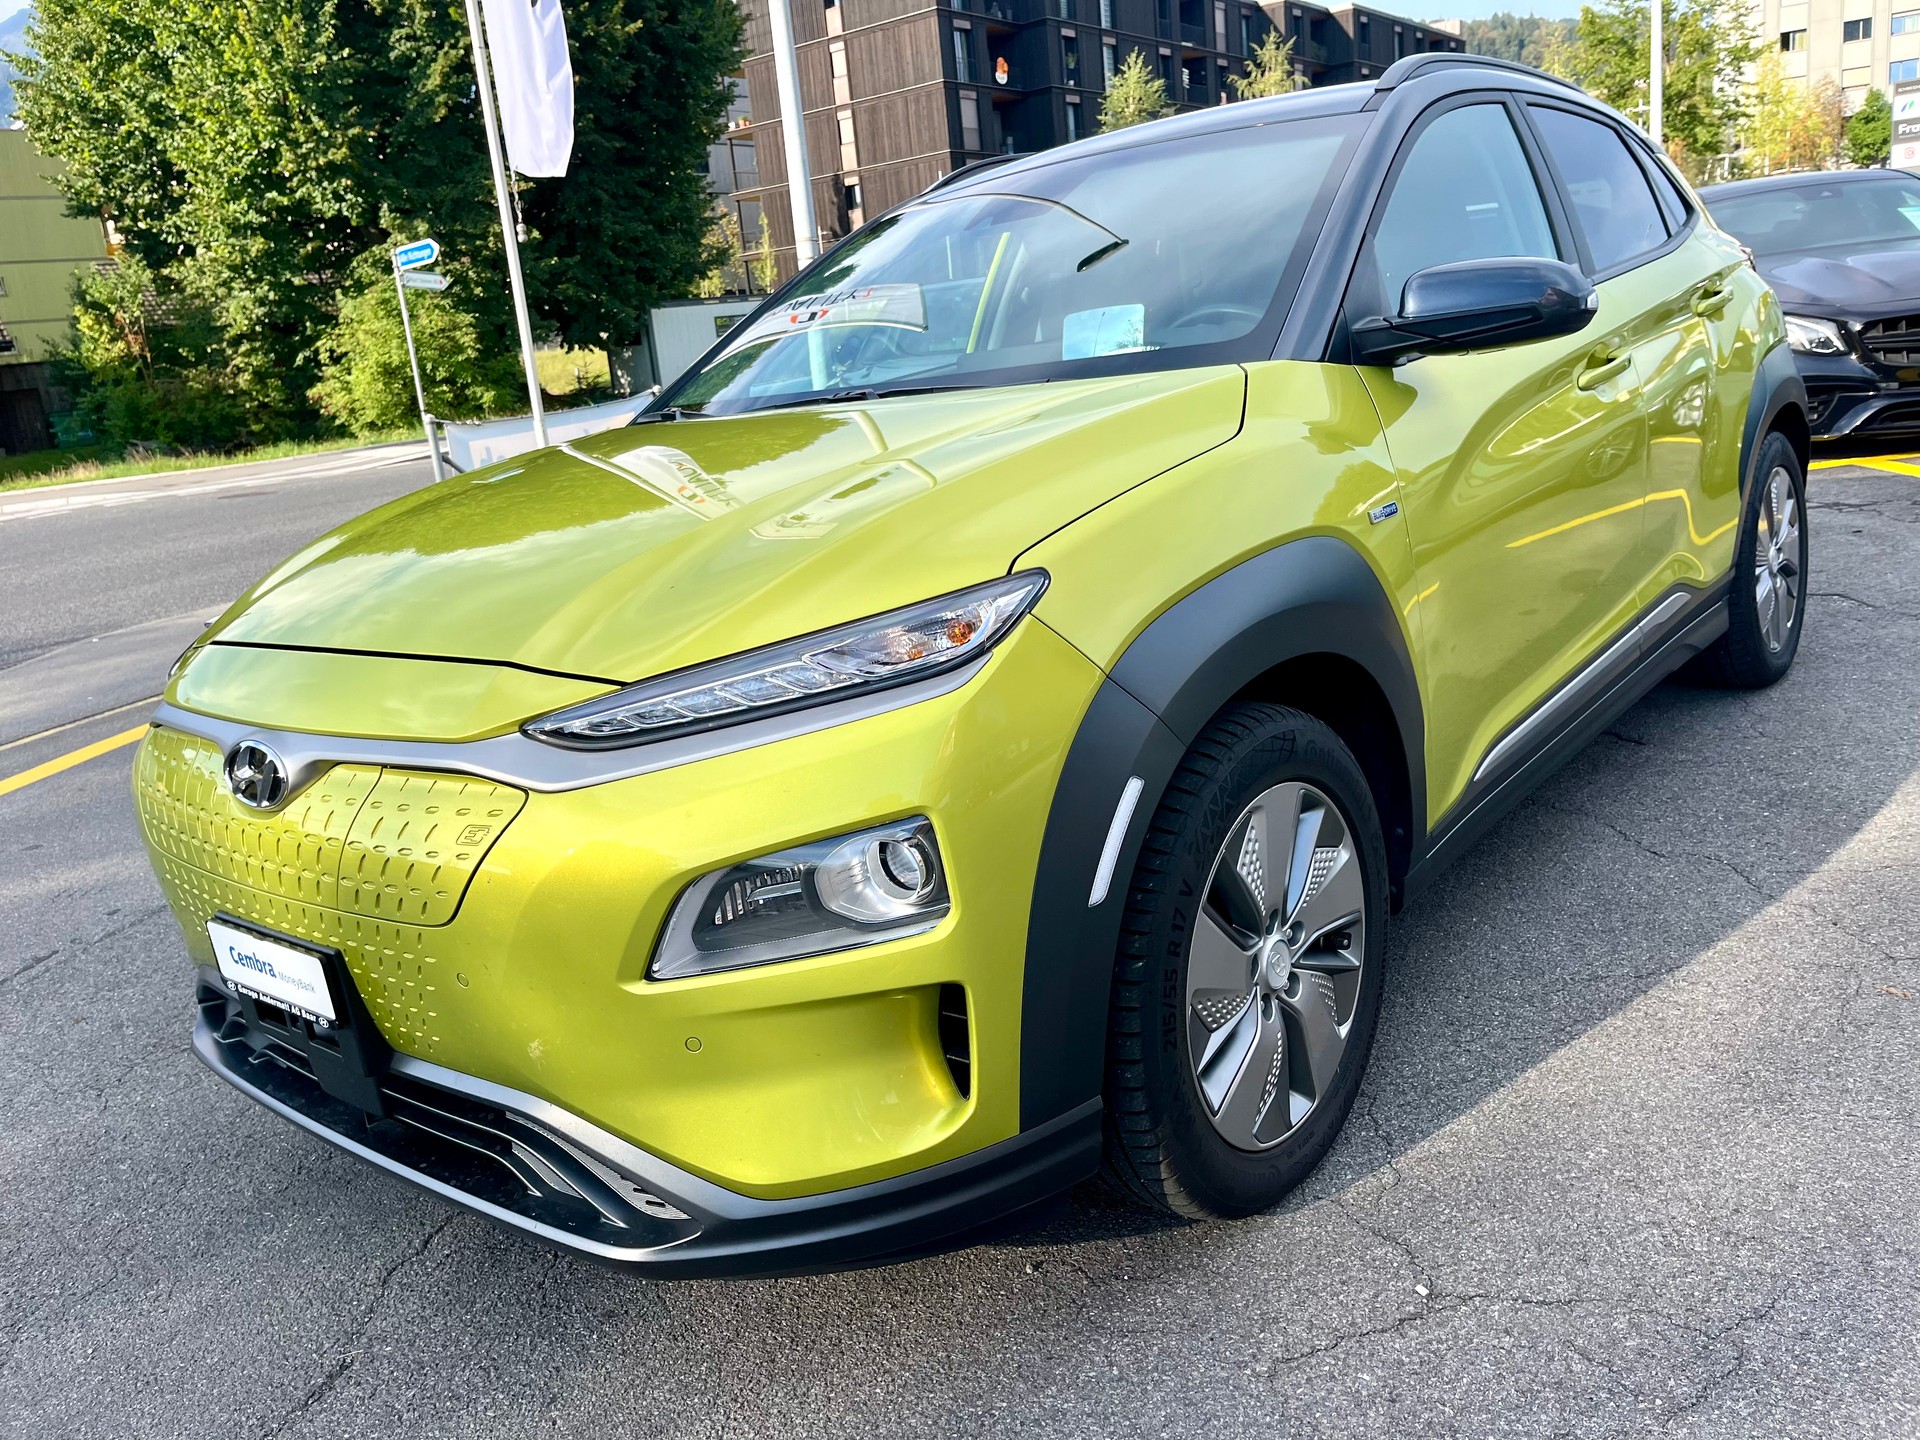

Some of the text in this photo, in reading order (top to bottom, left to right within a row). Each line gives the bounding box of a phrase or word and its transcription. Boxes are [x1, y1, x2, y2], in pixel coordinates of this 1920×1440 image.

[229, 945, 316, 994] Cembra MoneyBank
[1162, 878, 1194, 1054] 215/55 R 17 V
[237, 984, 317, 1022] Garage Andermatt AG Baar
